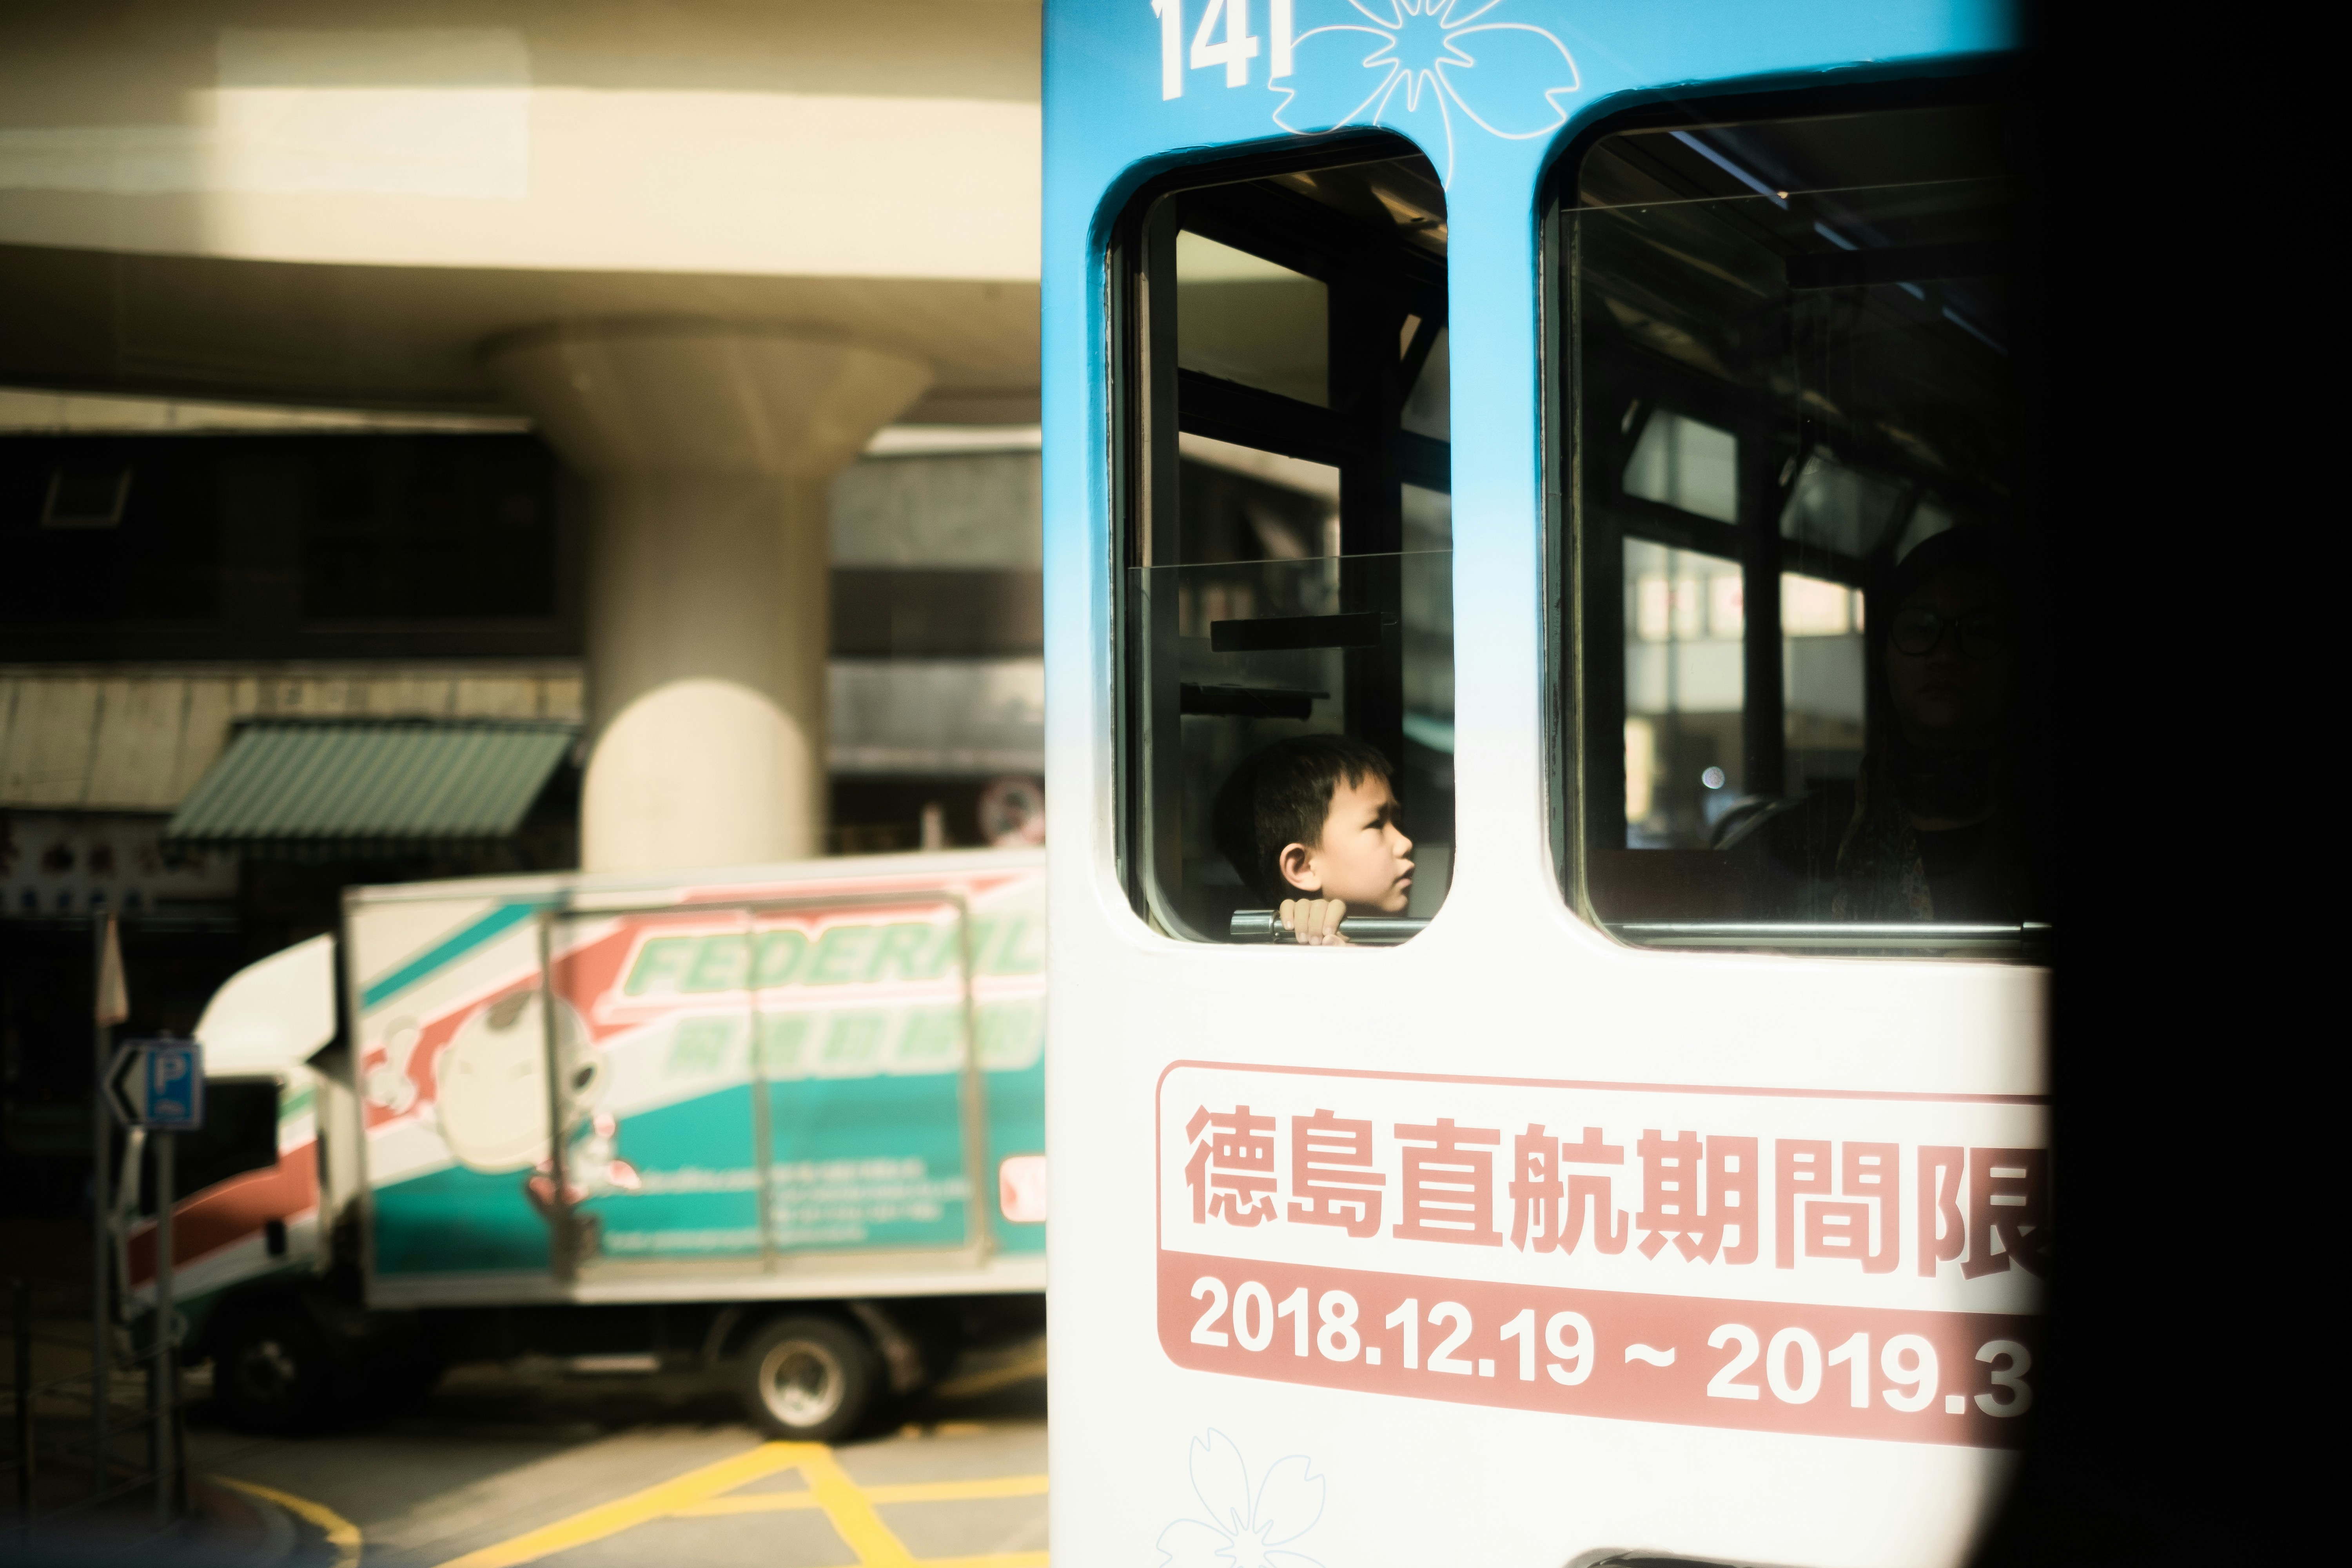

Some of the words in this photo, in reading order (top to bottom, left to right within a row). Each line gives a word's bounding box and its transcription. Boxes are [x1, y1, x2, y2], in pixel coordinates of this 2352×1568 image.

[623, 915, 1045, 996] FEDERAL
[154, 1056, 186, 1096] P
[1184, 1104, 2051, 1280] 德島直航期間限
[1190, 1276, 1595, 1385] 2018.12.19
[1706, 1323, 2033, 1418] 2019.3
